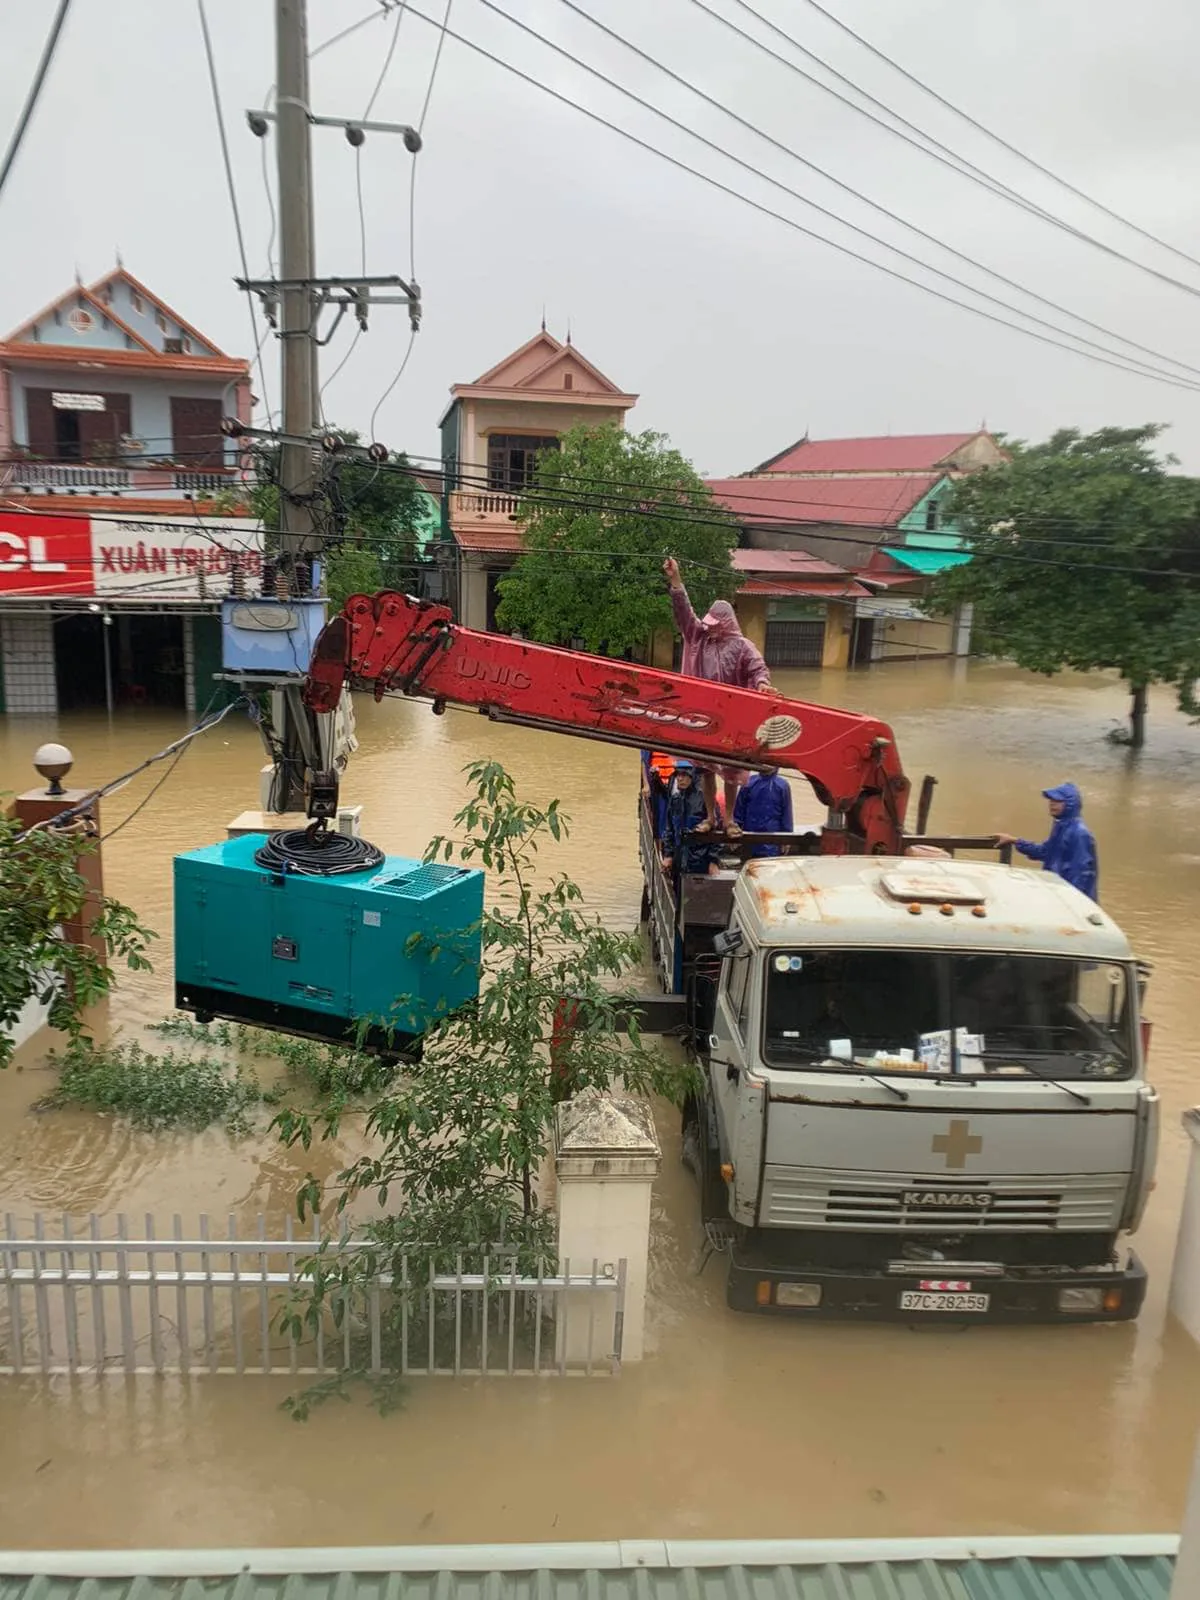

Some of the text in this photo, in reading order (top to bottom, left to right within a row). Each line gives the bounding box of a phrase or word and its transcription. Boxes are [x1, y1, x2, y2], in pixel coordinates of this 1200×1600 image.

[99, 540, 167, 575] XUÂN
[457, 655, 532, 690] UNIC
[903, 1294, 987, 1310] 37C-28259
